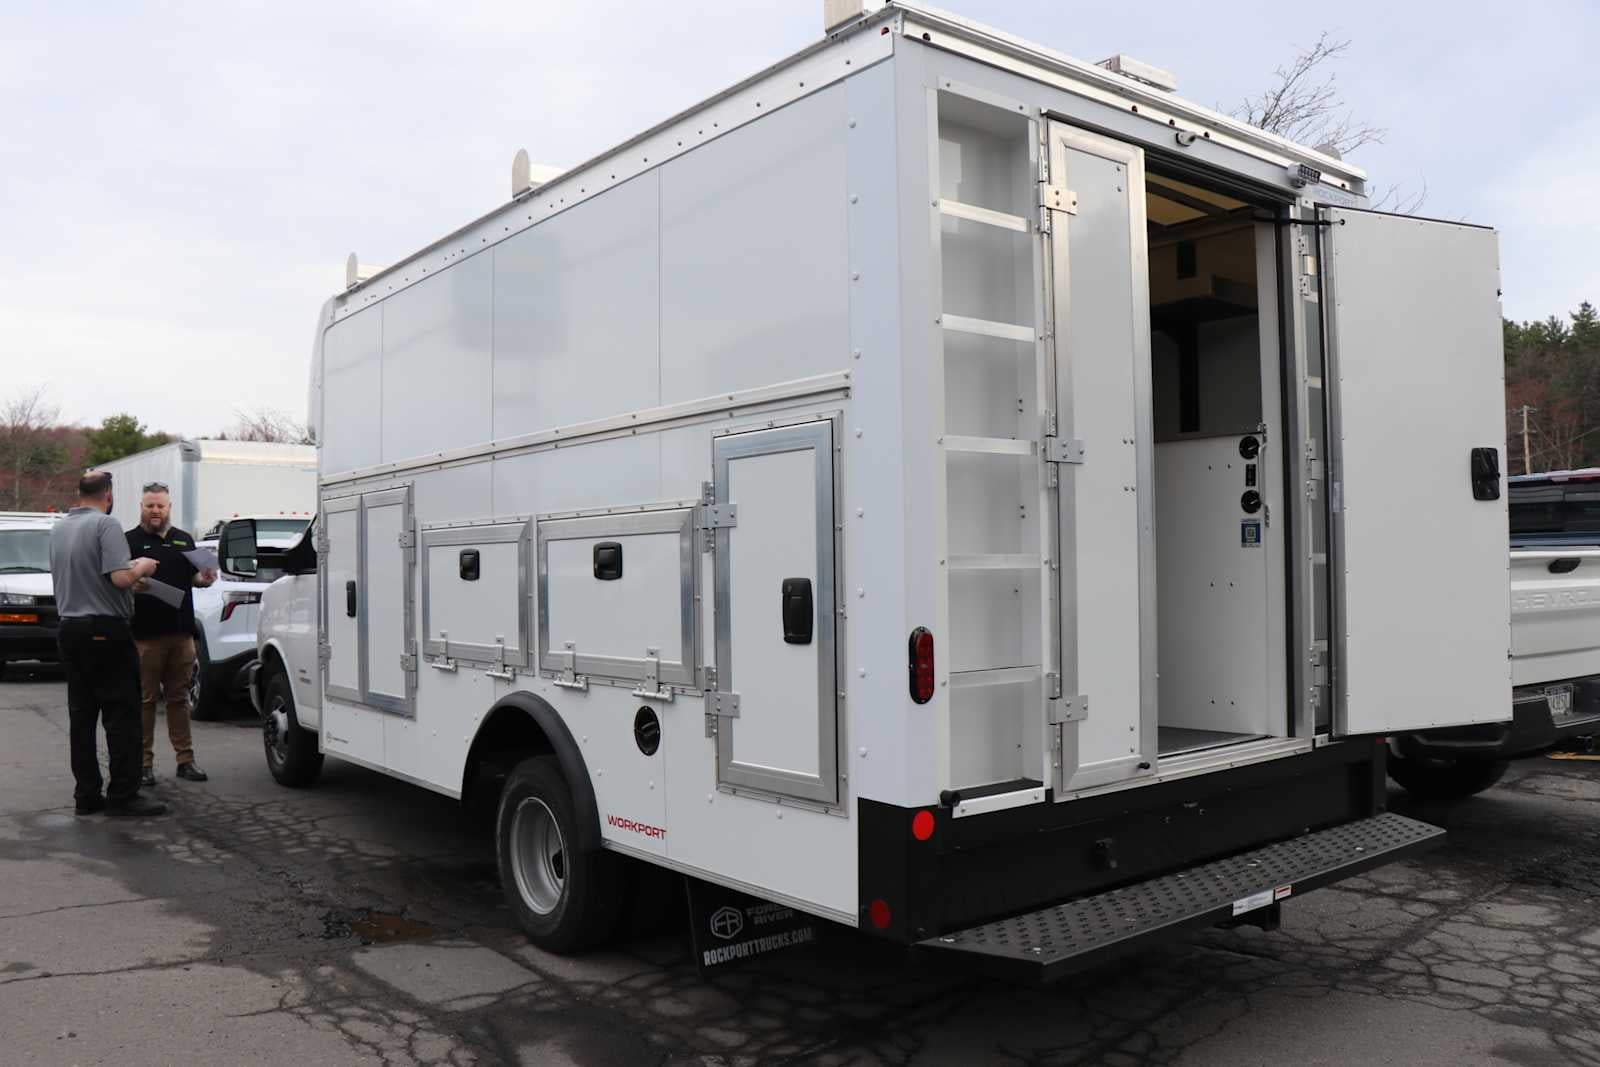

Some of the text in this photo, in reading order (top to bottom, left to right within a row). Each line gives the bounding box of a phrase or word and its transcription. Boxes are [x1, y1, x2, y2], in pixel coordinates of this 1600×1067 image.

[607, 815, 667, 840] WORKPORT
[753, 909, 795, 926] RIVER
[703, 927, 813, 967] ROCKPORTTRUCKS.COM
